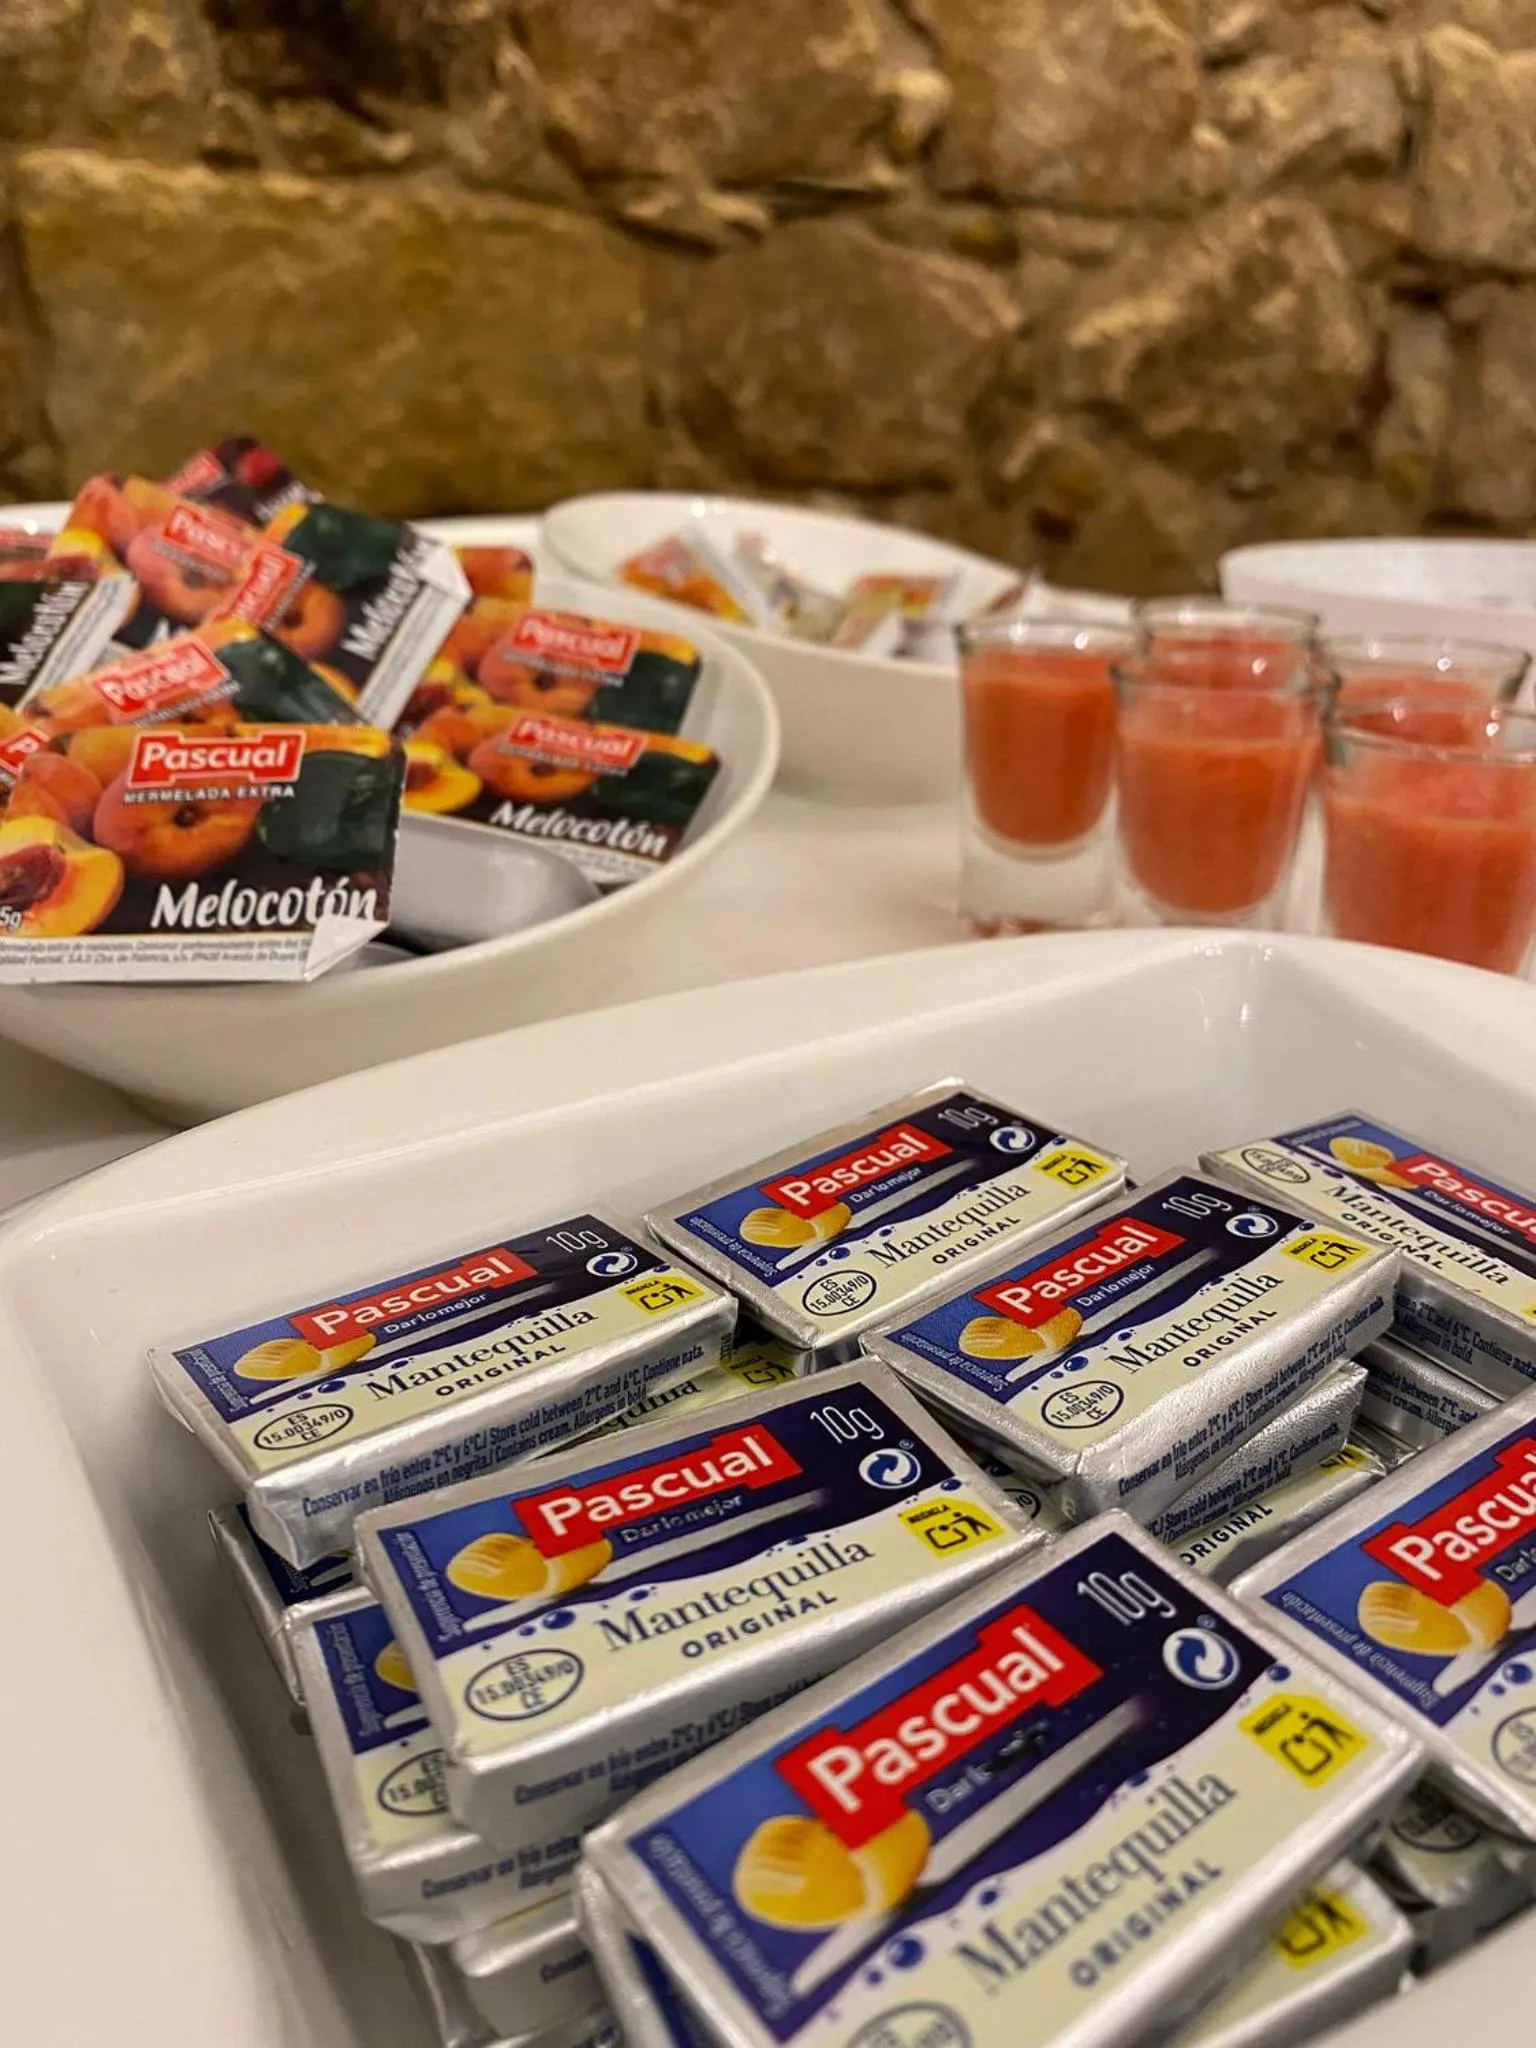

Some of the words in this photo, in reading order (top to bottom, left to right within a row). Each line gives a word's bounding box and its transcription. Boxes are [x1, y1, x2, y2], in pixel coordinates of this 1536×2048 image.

[101, 655, 208, 706] Pascual
[141, 740, 290, 771] Pascual
[124, 787, 230, 803] MERMELADA
[238, 784, 295, 799] EXTRA
[491, 800, 668, 857] Melocotón
[151, 876, 377, 929] Melocotón
[937, 1106, 999, 1131] 10g
[779, 1132, 929, 1206] Pascual
[866, 1181, 1031, 1269] Mantequilla
[1161, 1192, 1232, 1220] 10g
[546, 1228, 609, 1256] 10g
[932, 1215, 1021, 1264] ORIGINAL
[1324, 1184, 1510, 1286] Mantequilla
[1341, 1212, 1444, 1270] ORIGINAL
[312, 1256, 513, 1336] Pascual
[820, 1279, 838, 1291] ES
[996, 1225, 1159, 1314] Pascual
[841, 1294, 860, 1307] CE
[1105, 1271, 1285, 1376] Mantequilla
[361, 1305, 599, 1401] Mantequilla
[1182, 1308, 1278, 1368] ORIGINAL
[436, 1344, 567, 1396] ORIGINAL
[1059, 1391, 1079, 1404] ES
[287, 1413, 308, 1425] ES
[301, 1429, 321, 1441] CE
[302, 1484, 362, 1517] Conservar
[364, 1477, 379, 1494] en
[403, 1460, 432, 1480] entre
[490, 1421, 517, 1446] Store
[519, 1411, 540, 1433] cold
[542, 1397, 583, 1424] between
[604, 1378, 621, 1397] and
[643, 1354, 681, 1383] Contiene
[495, 1433, 537, 1463] Contains
[573, 1402, 616, 1431] Allergens
[810, 1406, 884, 1445] 10g
[1086, 1406, 1107, 1420] CE
[539, 1436, 774, 1537] Pascual
[1180, 1500, 1272, 1566] ORIGINAL
[593, 1536, 875, 1653] Mantequilla
[1078, 1571, 1176, 1626] 10g
[681, 1590, 837, 1660] ORIGINAL
[807, 1627, 1066, 1813] Pascual
[953, 1770, 1238, 1994] Mantequilla
[1068, 1858, 1222, 1988] ORIGINAL
